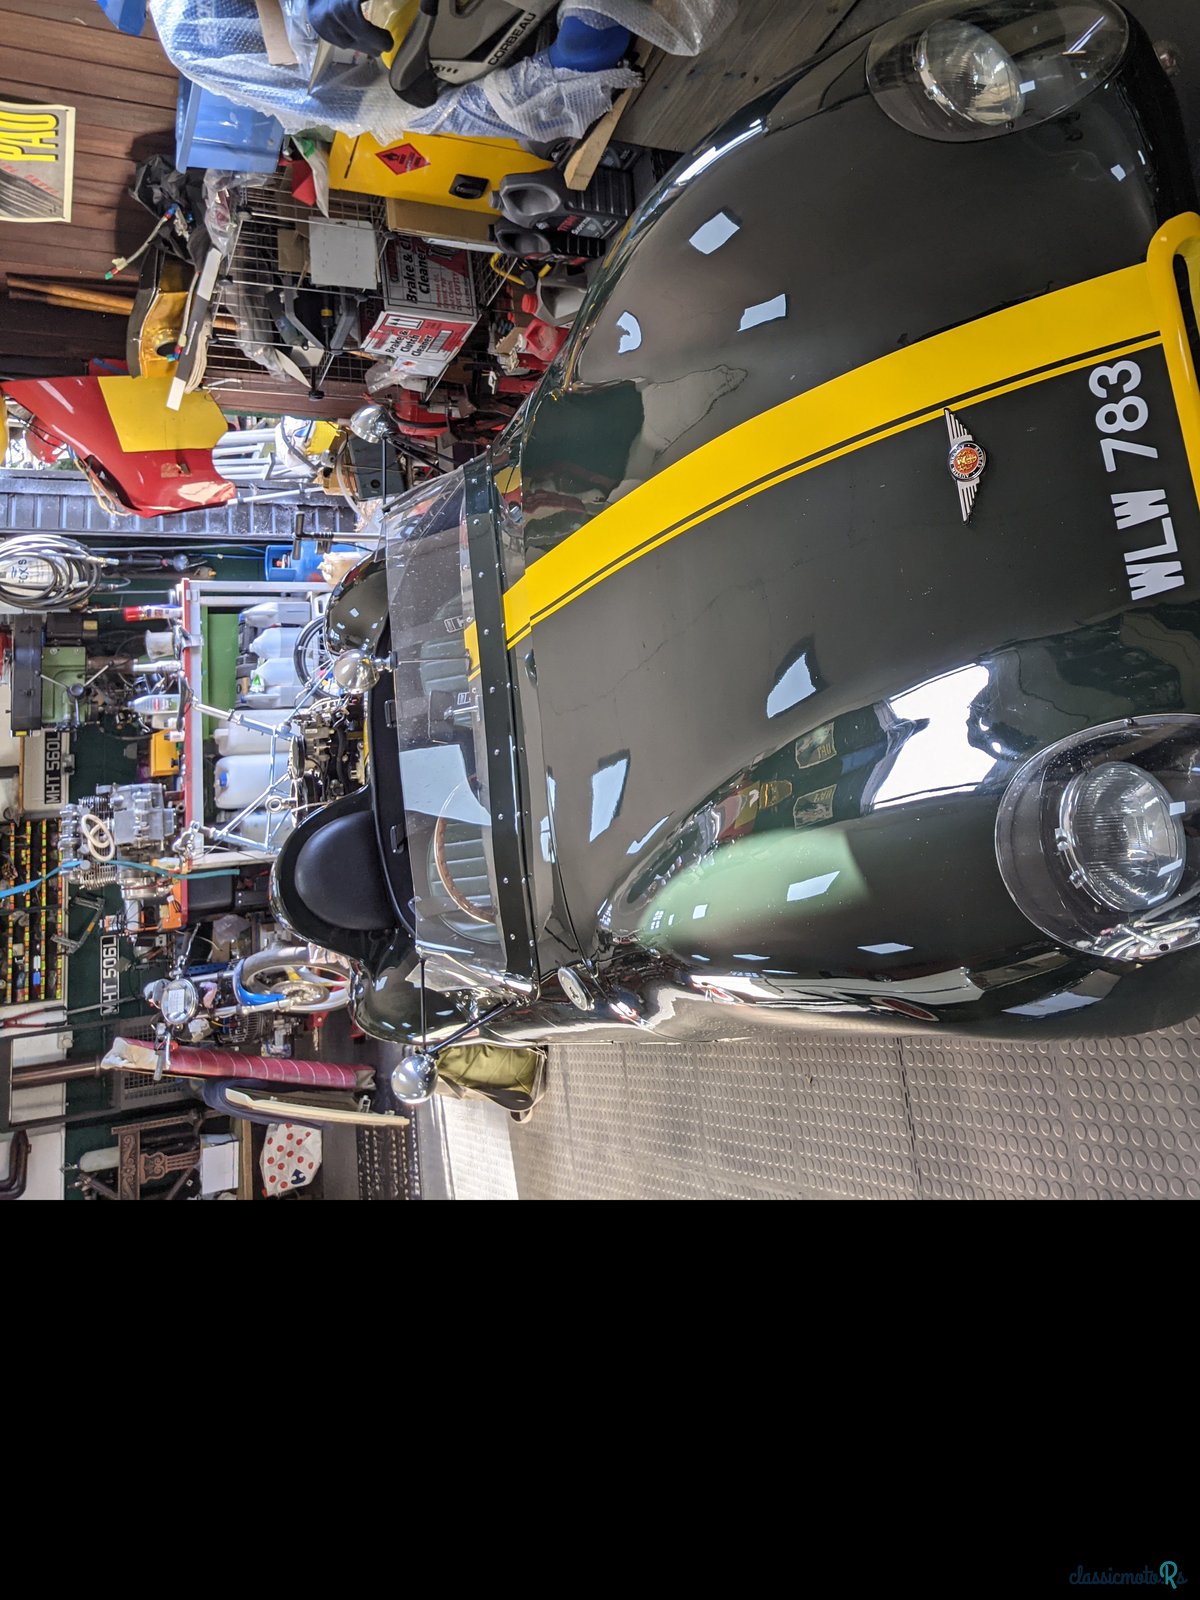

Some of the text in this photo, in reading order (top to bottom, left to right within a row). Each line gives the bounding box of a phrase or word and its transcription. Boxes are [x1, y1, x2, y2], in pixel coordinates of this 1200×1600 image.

[487, 12, 536, 66] CORBEAU
[403, 253, 413, 262] &
[418, 248, 431, 294] Cleaner
[404, 265, 418, 303] Brake
[386, 336, 404, 354] Brake
[401, 334, 420, 352] Clutch
[412, 335, 432, 356] Cleaner
[1088, 360, 1185, 600] WLW 783
[46, 732, 61, 804] MHT 560L
[103, 937, 118, 1013] MHT 506L
